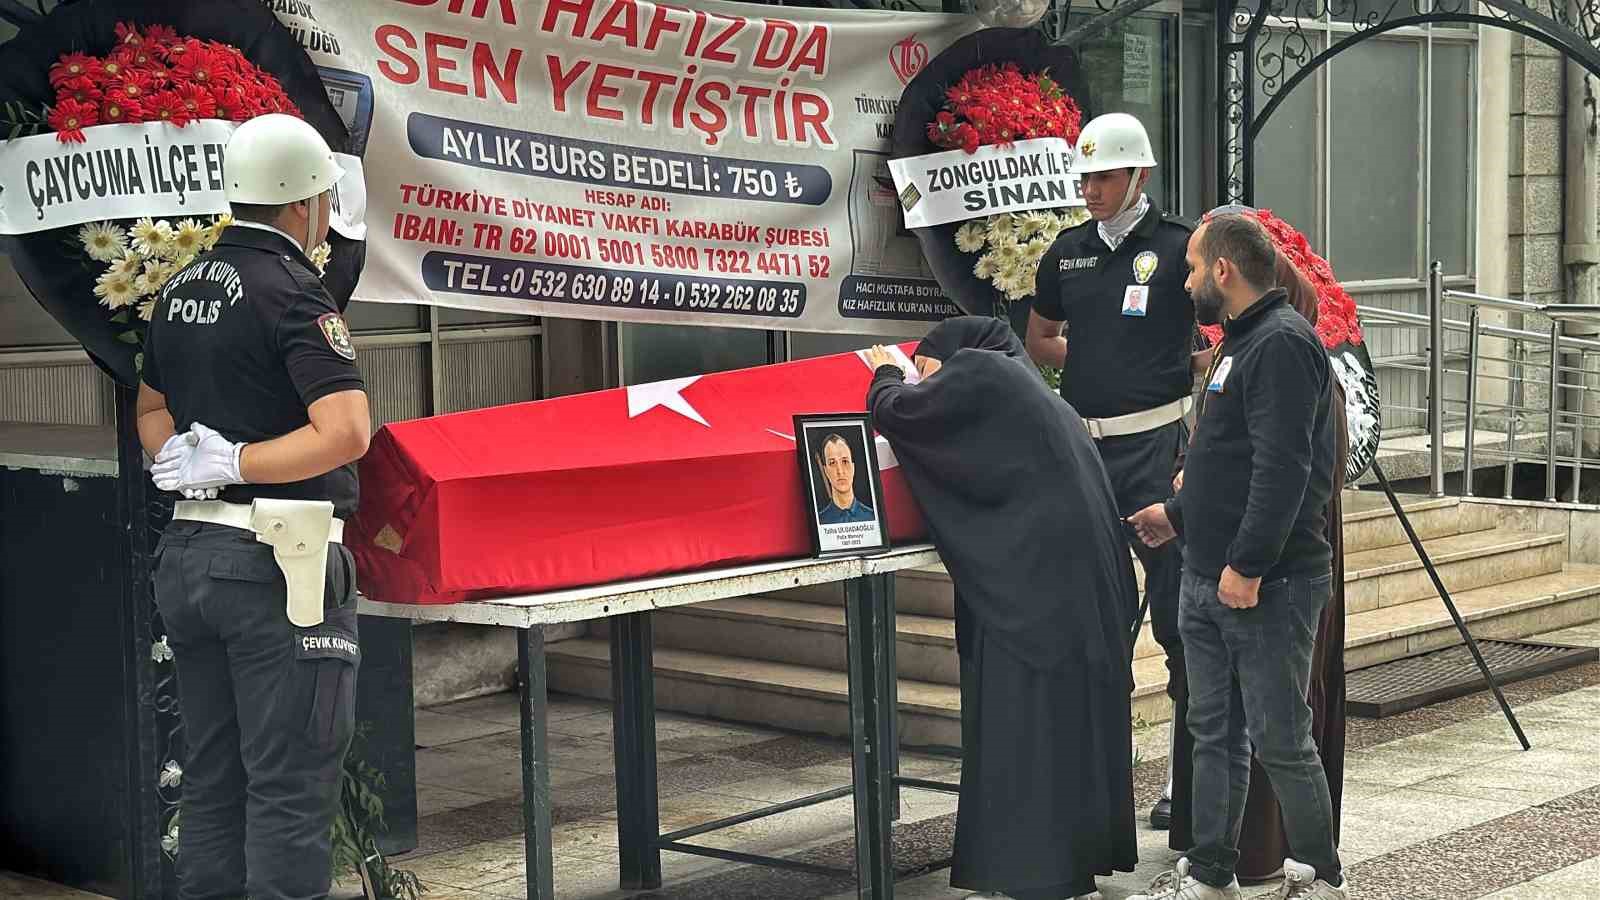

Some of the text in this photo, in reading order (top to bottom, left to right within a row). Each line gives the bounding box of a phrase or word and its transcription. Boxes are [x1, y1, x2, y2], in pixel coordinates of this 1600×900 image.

[541, 0, 747, 63] HAFIZ
[752, 18, 828, 75] DA
[374, 24, 834, 146] SEN YETİŞTİR
[25, 147, 146, 221] ÇAYCUMA
[144, 134, 201, 206] İLÇE
[441, 127, 525, 169] AYLIK
[529, 140, 607, 180] BURS
[612, 152, 721, 193] BEDELİ:
[727, 166, 778, 197] 750
[926, 153, 1044, 193] ZONGULDAK
[1045, 146, 1061, 175] İL
[399, 183, 830, 249] TÜRKİYE DİYANET VAKFI KARABÜK ŞUBESİ
[584, 188, 671, 212] HESAP ADI:
[962, 179, 1067, 212] SİNAN
[393, 212, 831, 280] IBAN: TR 62 0001 5001 5800 7322 4471 52
[528, 269, 568, 298] 532
[571, 273, 607, 303] 630
[610, 276, 634, 305] 89
[639, 278, 660, 306] 14
[674, 281, 685, 307] 0
[689, 282, 721, 309] 532
[722, 284, 754, 311] 262
[756, 286, 777, 312] 08
[779, 288, 800, 314] 35
[842, 299, 857, 310] KIZ
[857, 299, 896, 313] HAFIZLIK
[855, 281, 876, 294] HACI
[876, 283, 915, 297] MUSTAFA
